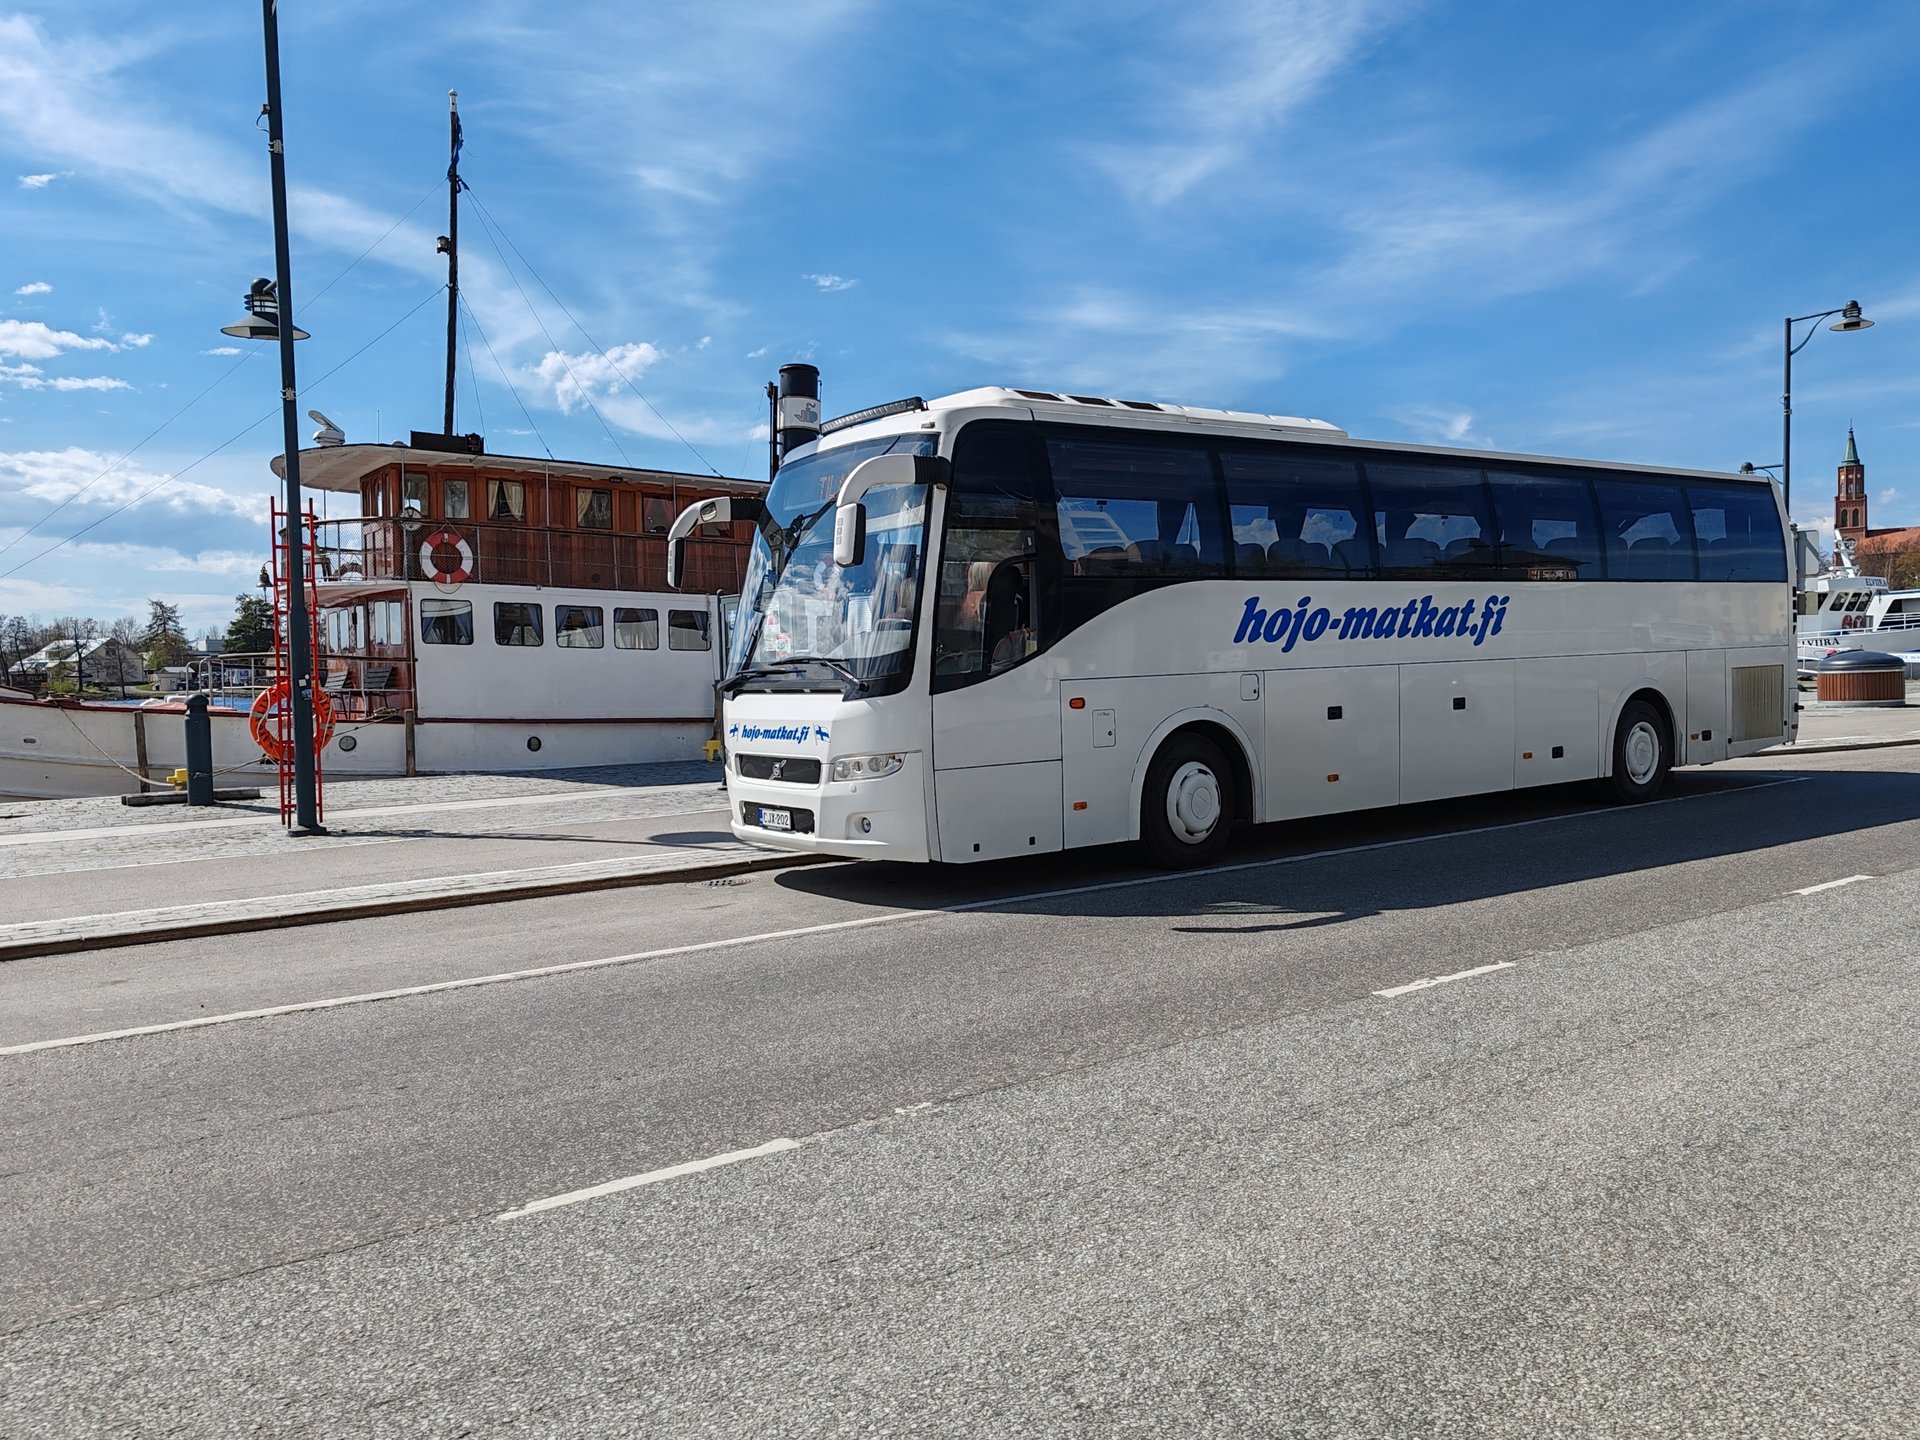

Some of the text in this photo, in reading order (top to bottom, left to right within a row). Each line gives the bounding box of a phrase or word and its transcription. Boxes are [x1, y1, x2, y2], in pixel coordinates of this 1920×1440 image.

[1233, 595, 1510, 653] hojo-matkat.fi
[1798, 638, 1840, 646] LVIIRA
[741, 725, 811, 744] hojo-matkat.fi
[763, 812, 789, 826] CJX-202
